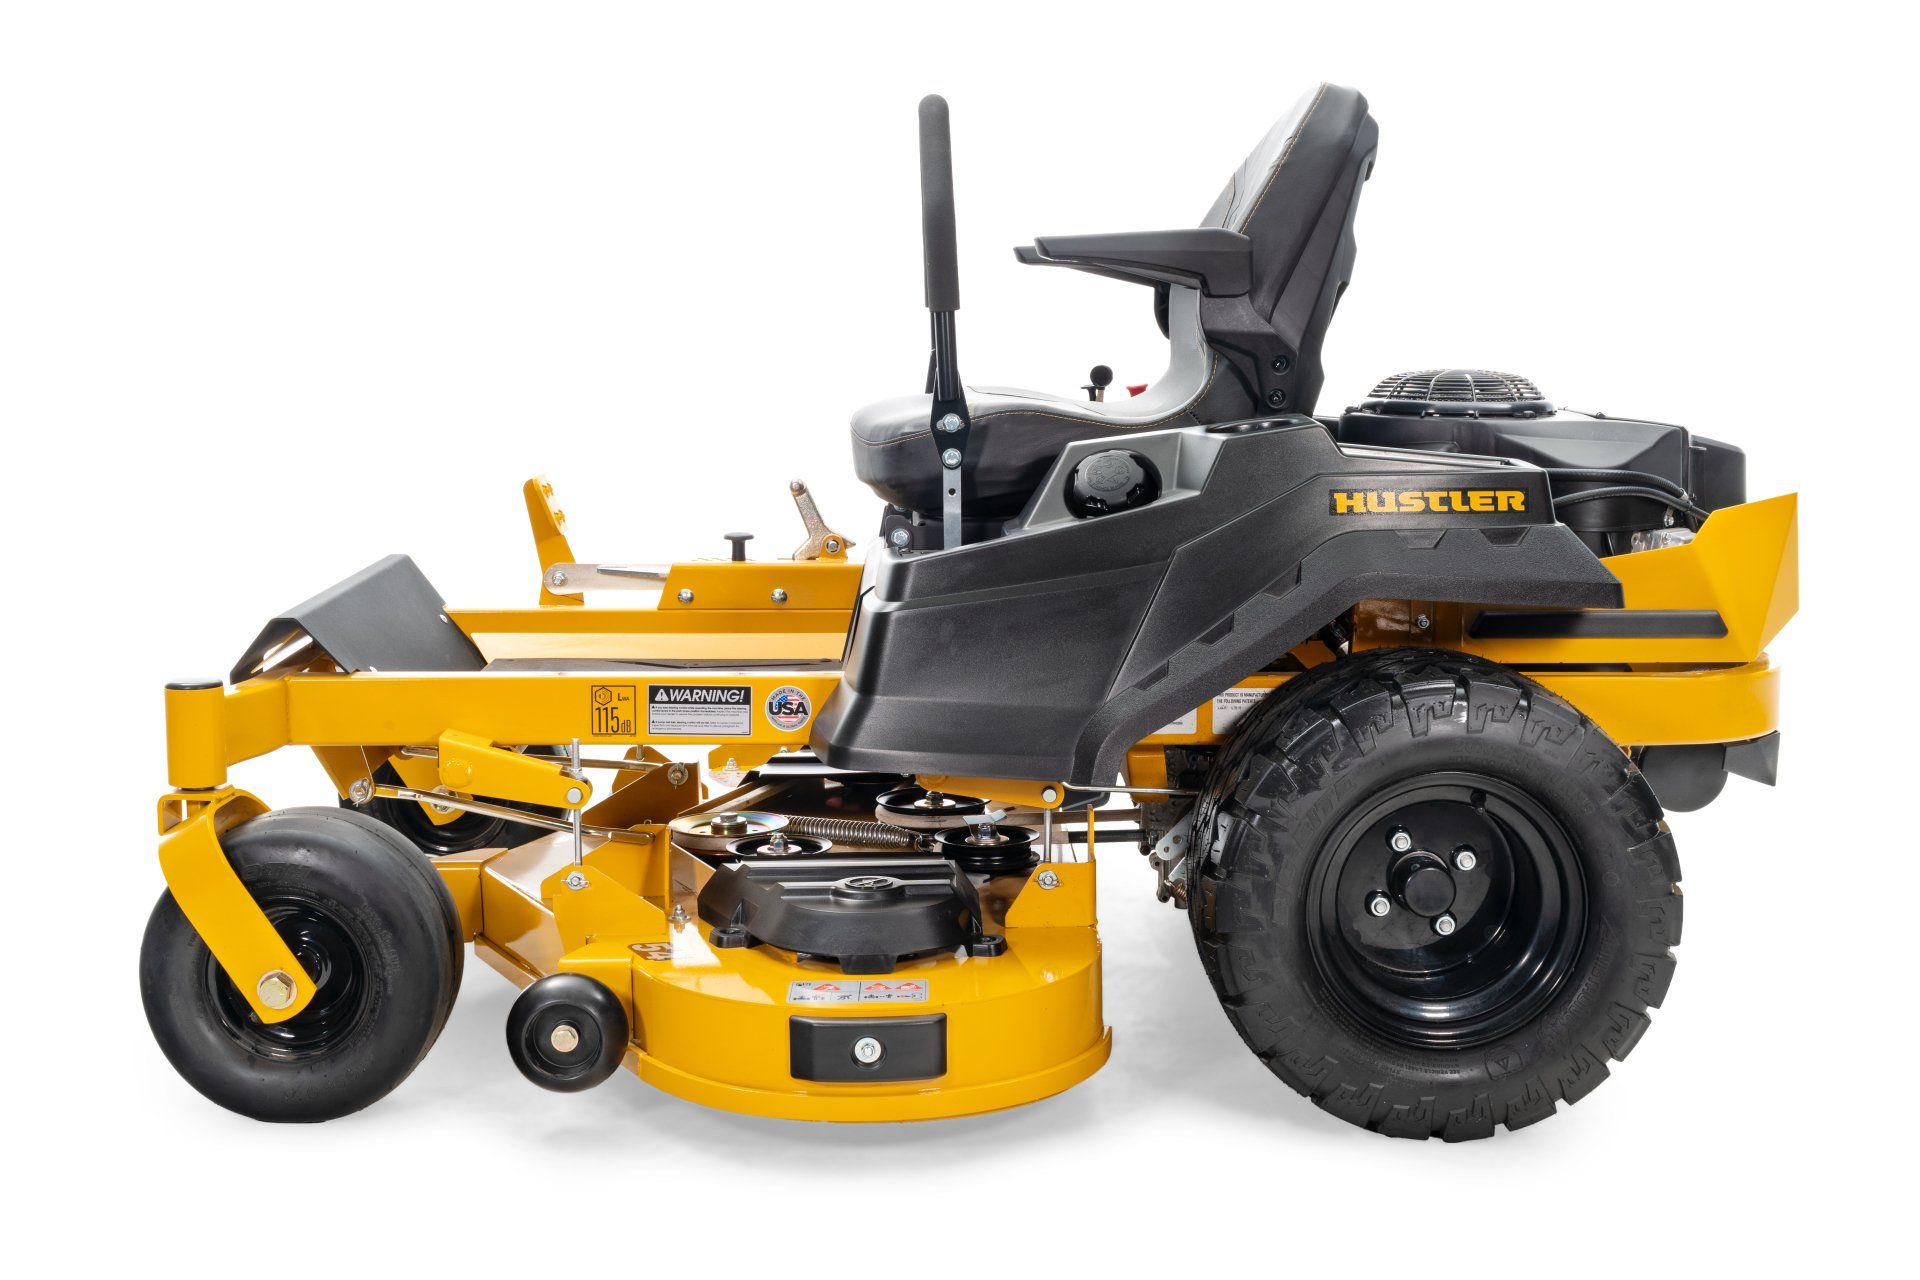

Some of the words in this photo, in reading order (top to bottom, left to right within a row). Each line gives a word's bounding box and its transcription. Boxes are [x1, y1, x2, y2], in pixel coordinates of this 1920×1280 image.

[1333, 490, 1525, 513] HUSTLER
[668, 688, 745, 703] WARNING!
[771, 688, 786, 700] MADE
[768, 701, 809, 715] USA
[594, 706, 620, 733] 115
[620, 719, 632, 733] dB
